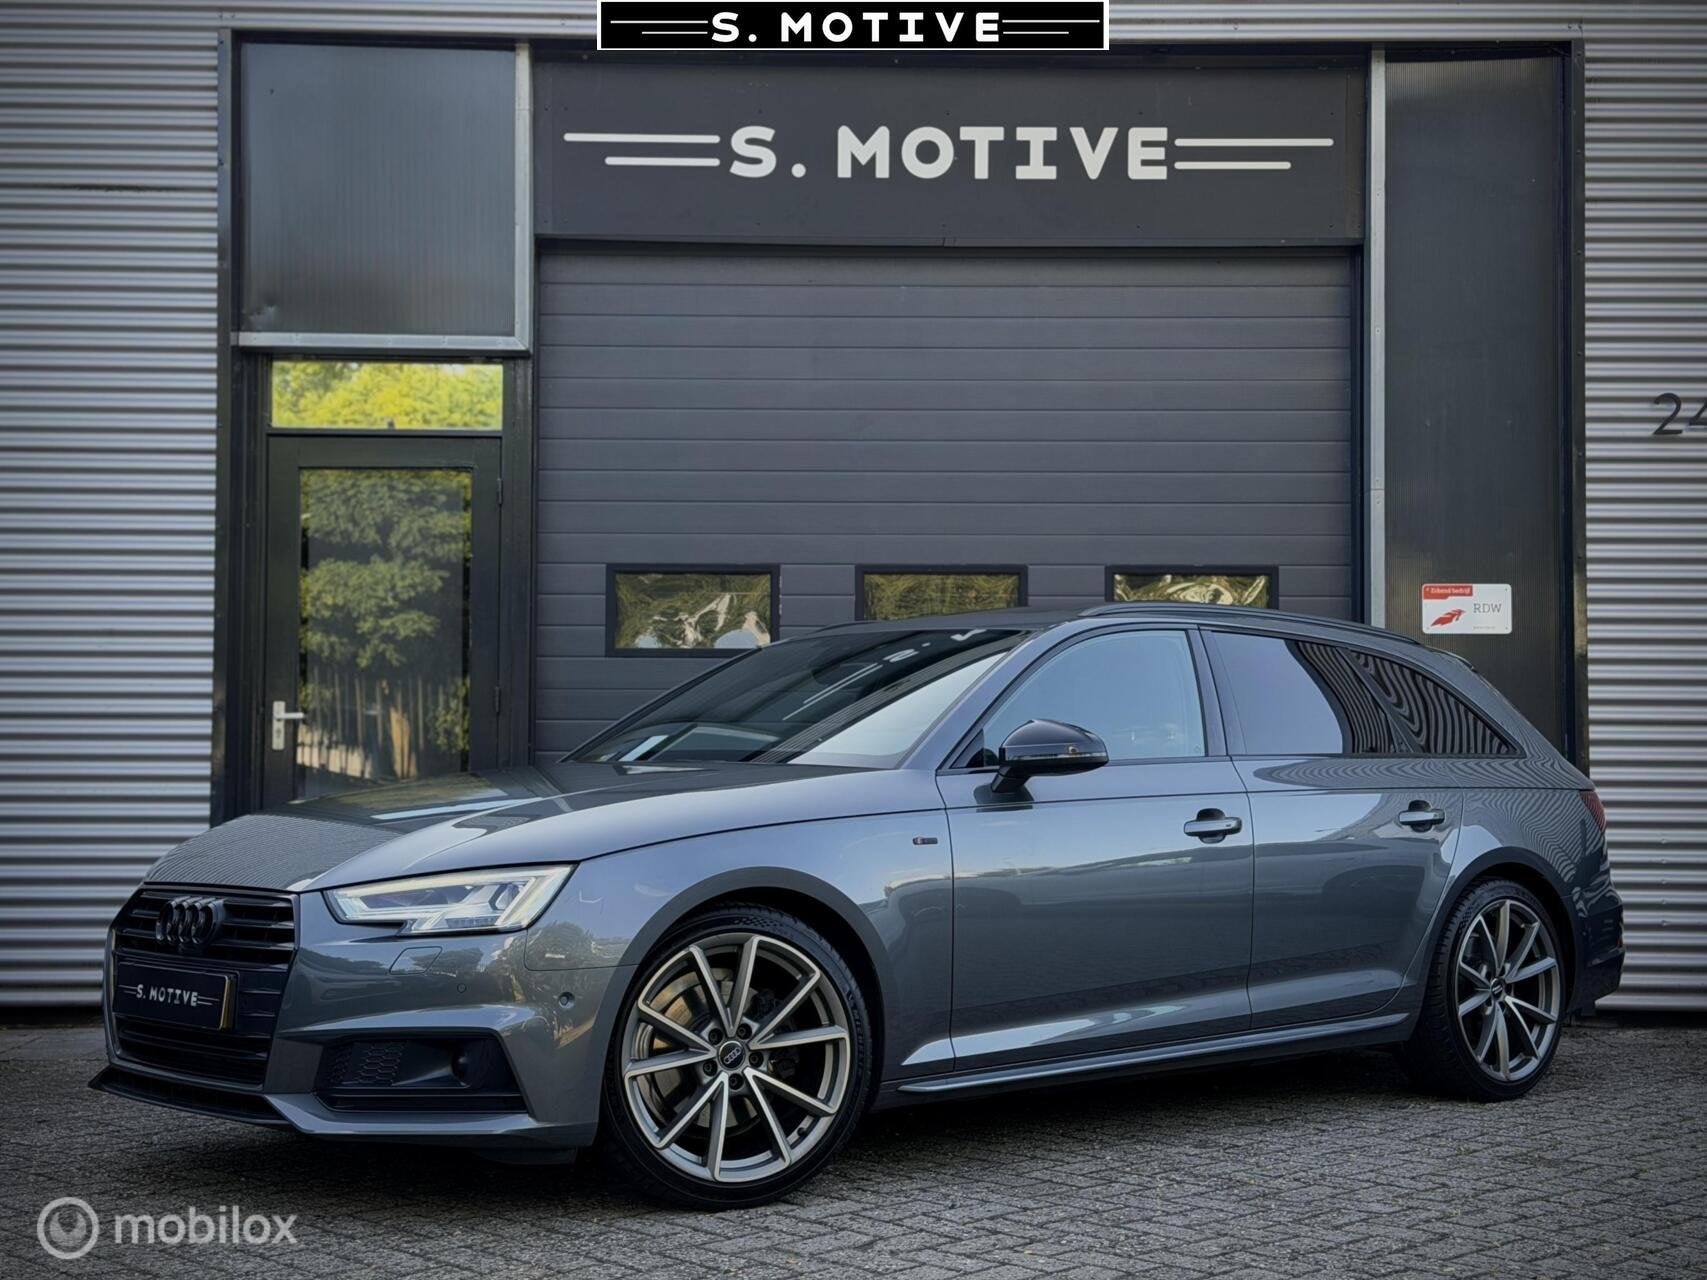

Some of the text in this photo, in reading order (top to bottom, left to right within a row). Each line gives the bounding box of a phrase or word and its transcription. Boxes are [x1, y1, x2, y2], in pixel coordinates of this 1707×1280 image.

[729, 125, 1169, 181] S. MOTIVE
[1473, 603, 1502, 613] RDW
[136, 984, 199, 1007] S. MOTIVE
